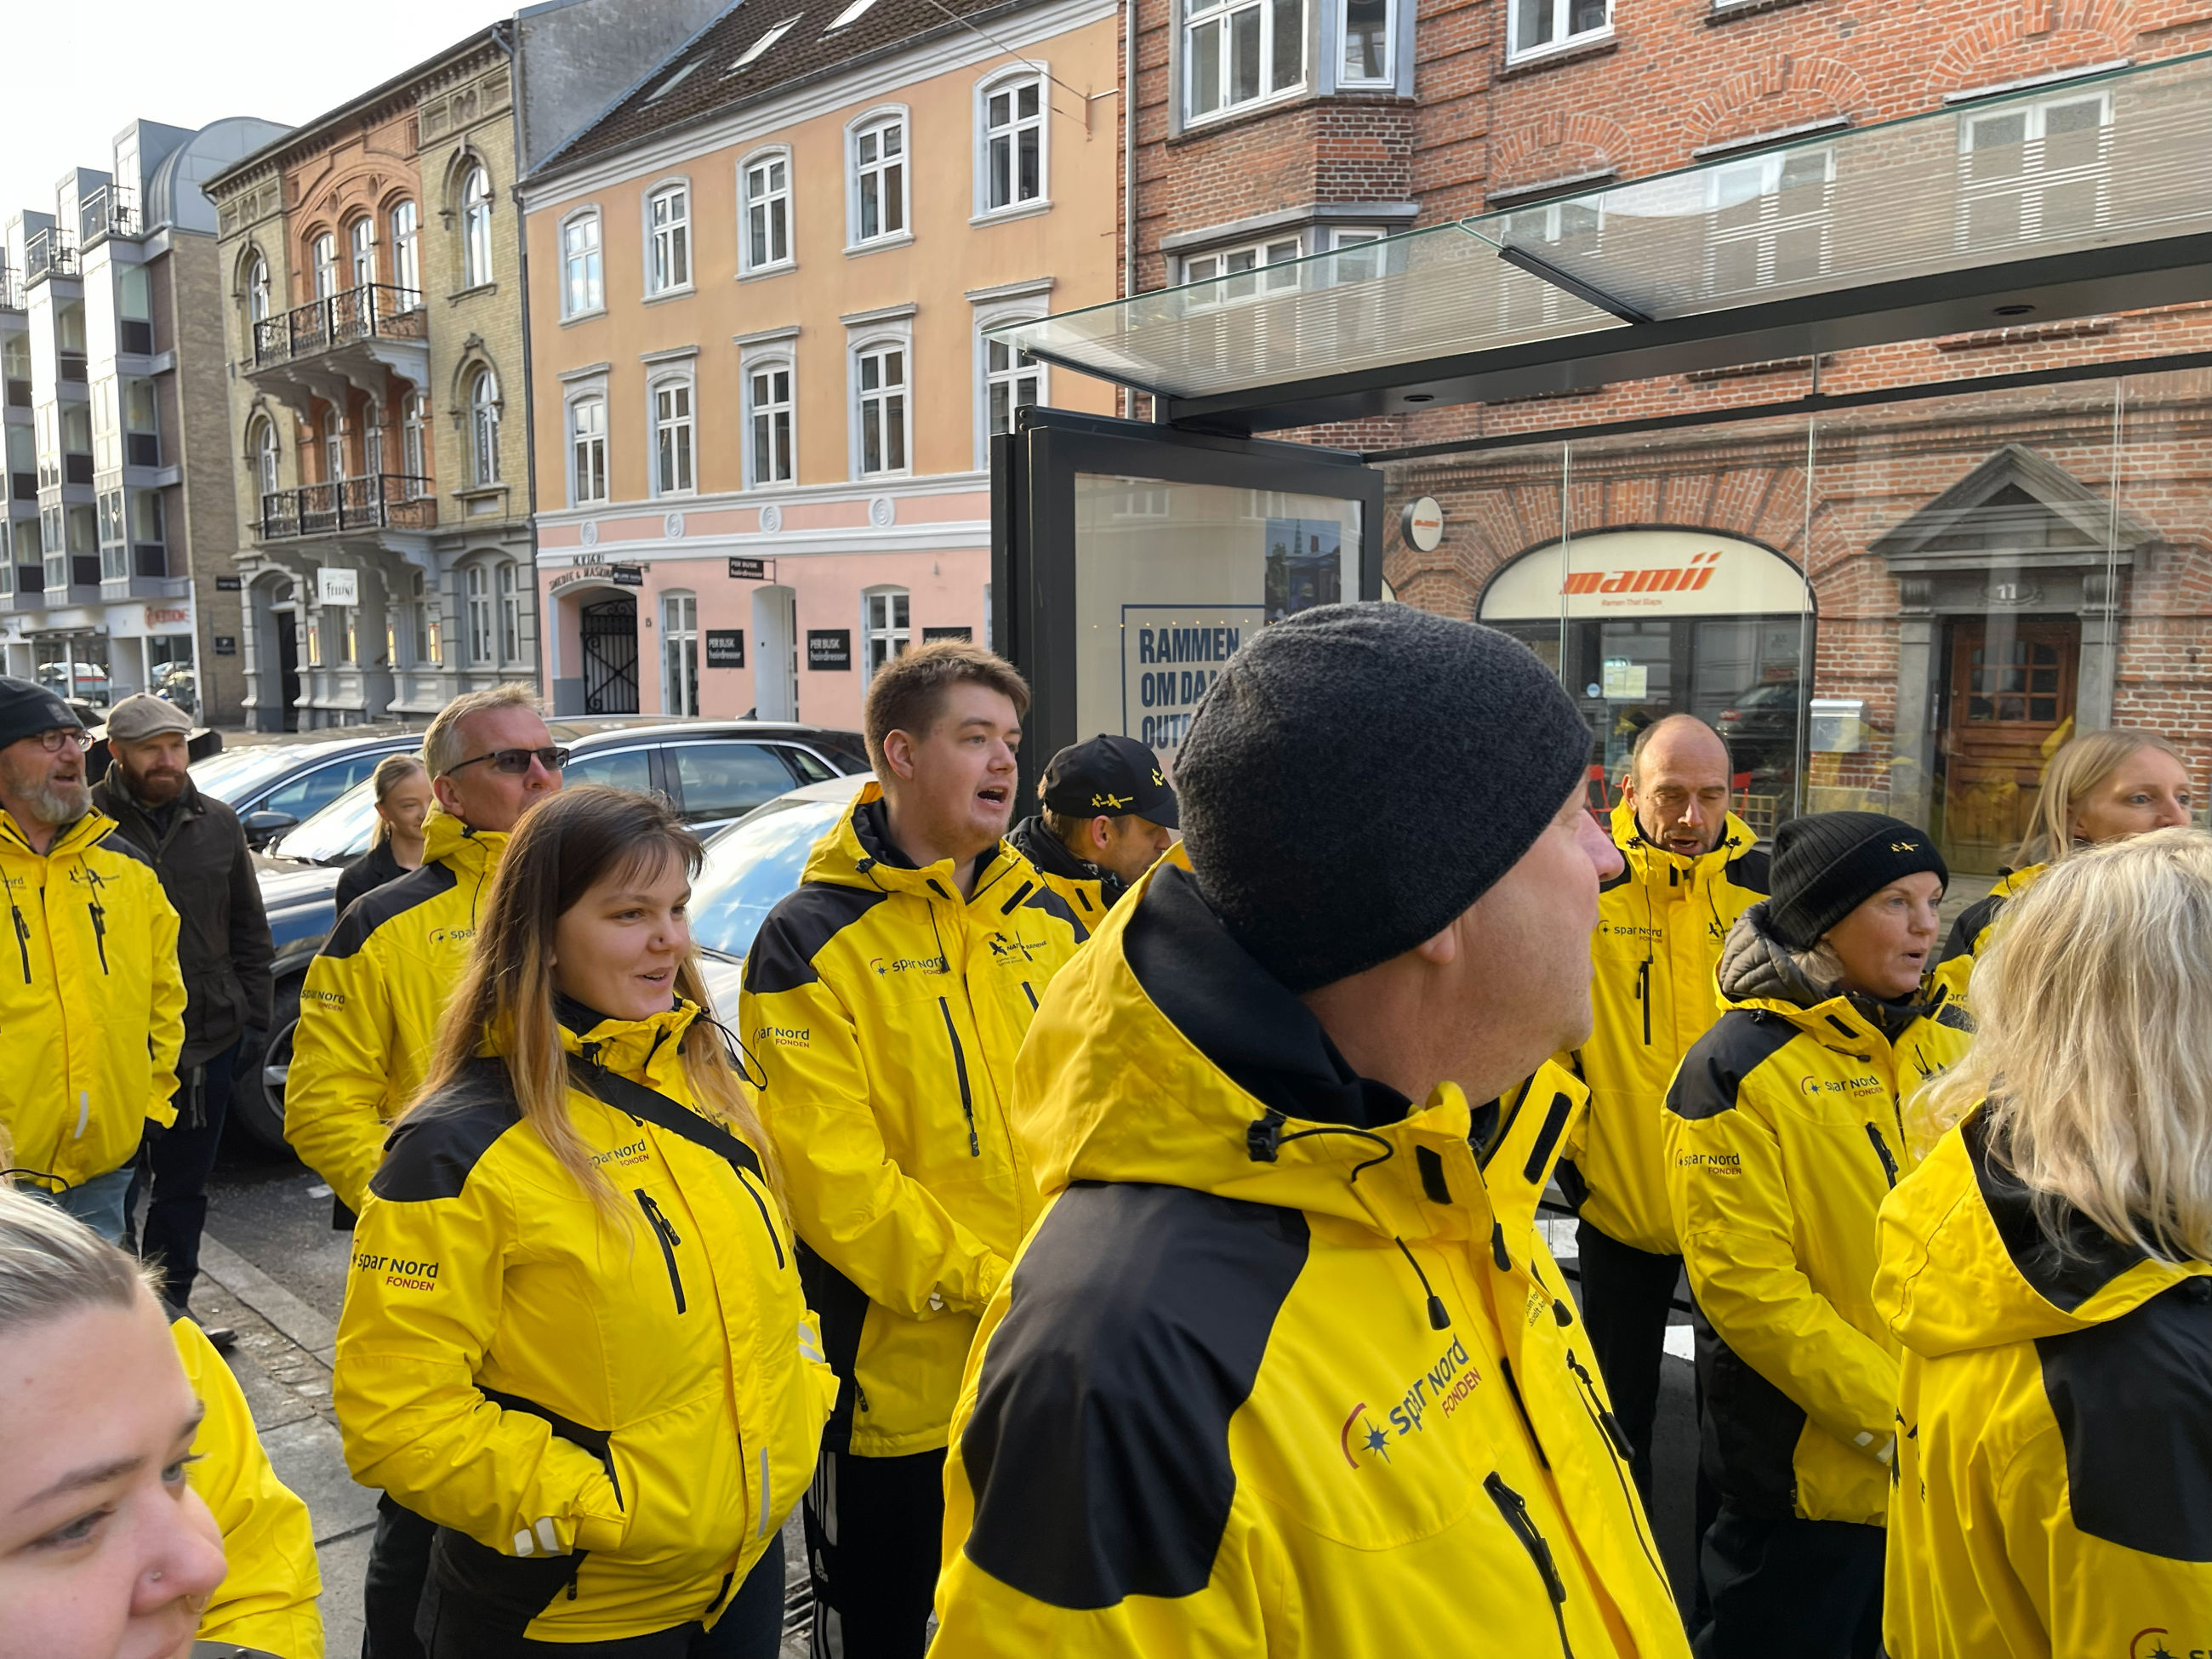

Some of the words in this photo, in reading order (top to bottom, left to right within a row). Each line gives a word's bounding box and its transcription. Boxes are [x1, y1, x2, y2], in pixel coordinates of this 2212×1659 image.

[1559, 551, 1723, 595] mamii
[1997, 584, 2016, 599] 11
[708, 638, 718, 648] PER
[719, 638, 735, 648] BUSK
[810, 639, 821, 649] PER
[822, 639, 841, 649] BUSK
[1139, 628, 1240, 664] RAMMEN
[709, 649, 742, 659] hairdresser
[810, 651, 847, 661] hairdresser
[1141, 671, 1176, 708] OM
[1142, 713, 1191, 750] OUT
[450, 928, 474, 941] spa
[1614, 926, 1637, 936] spar
[1639, 926, 1662, 937] Nord
[317, 990, 345, 1004] Nord
[775, 1028, 810, 1040] Nord
[775, 1038, 810, 1048] FONDEN
[589, 1151, 612, 1169] par
[613, 1138, 647, 1158] Nord
[1707, 1152, 1741, 1165] Nord
[619, 1154, 650, 1167] FONDEN
[1707, 1166, 1742, 1175] FONDEN
[357, 1253, 389, 1272] spar
[390, 1258, 439, 1279] Nord
[385, 1276, 435, 1291] FONDEN
[1427, 1332, 1470, 1396] Nord
[1441, 1366, 1482, 1419] FONDEN
